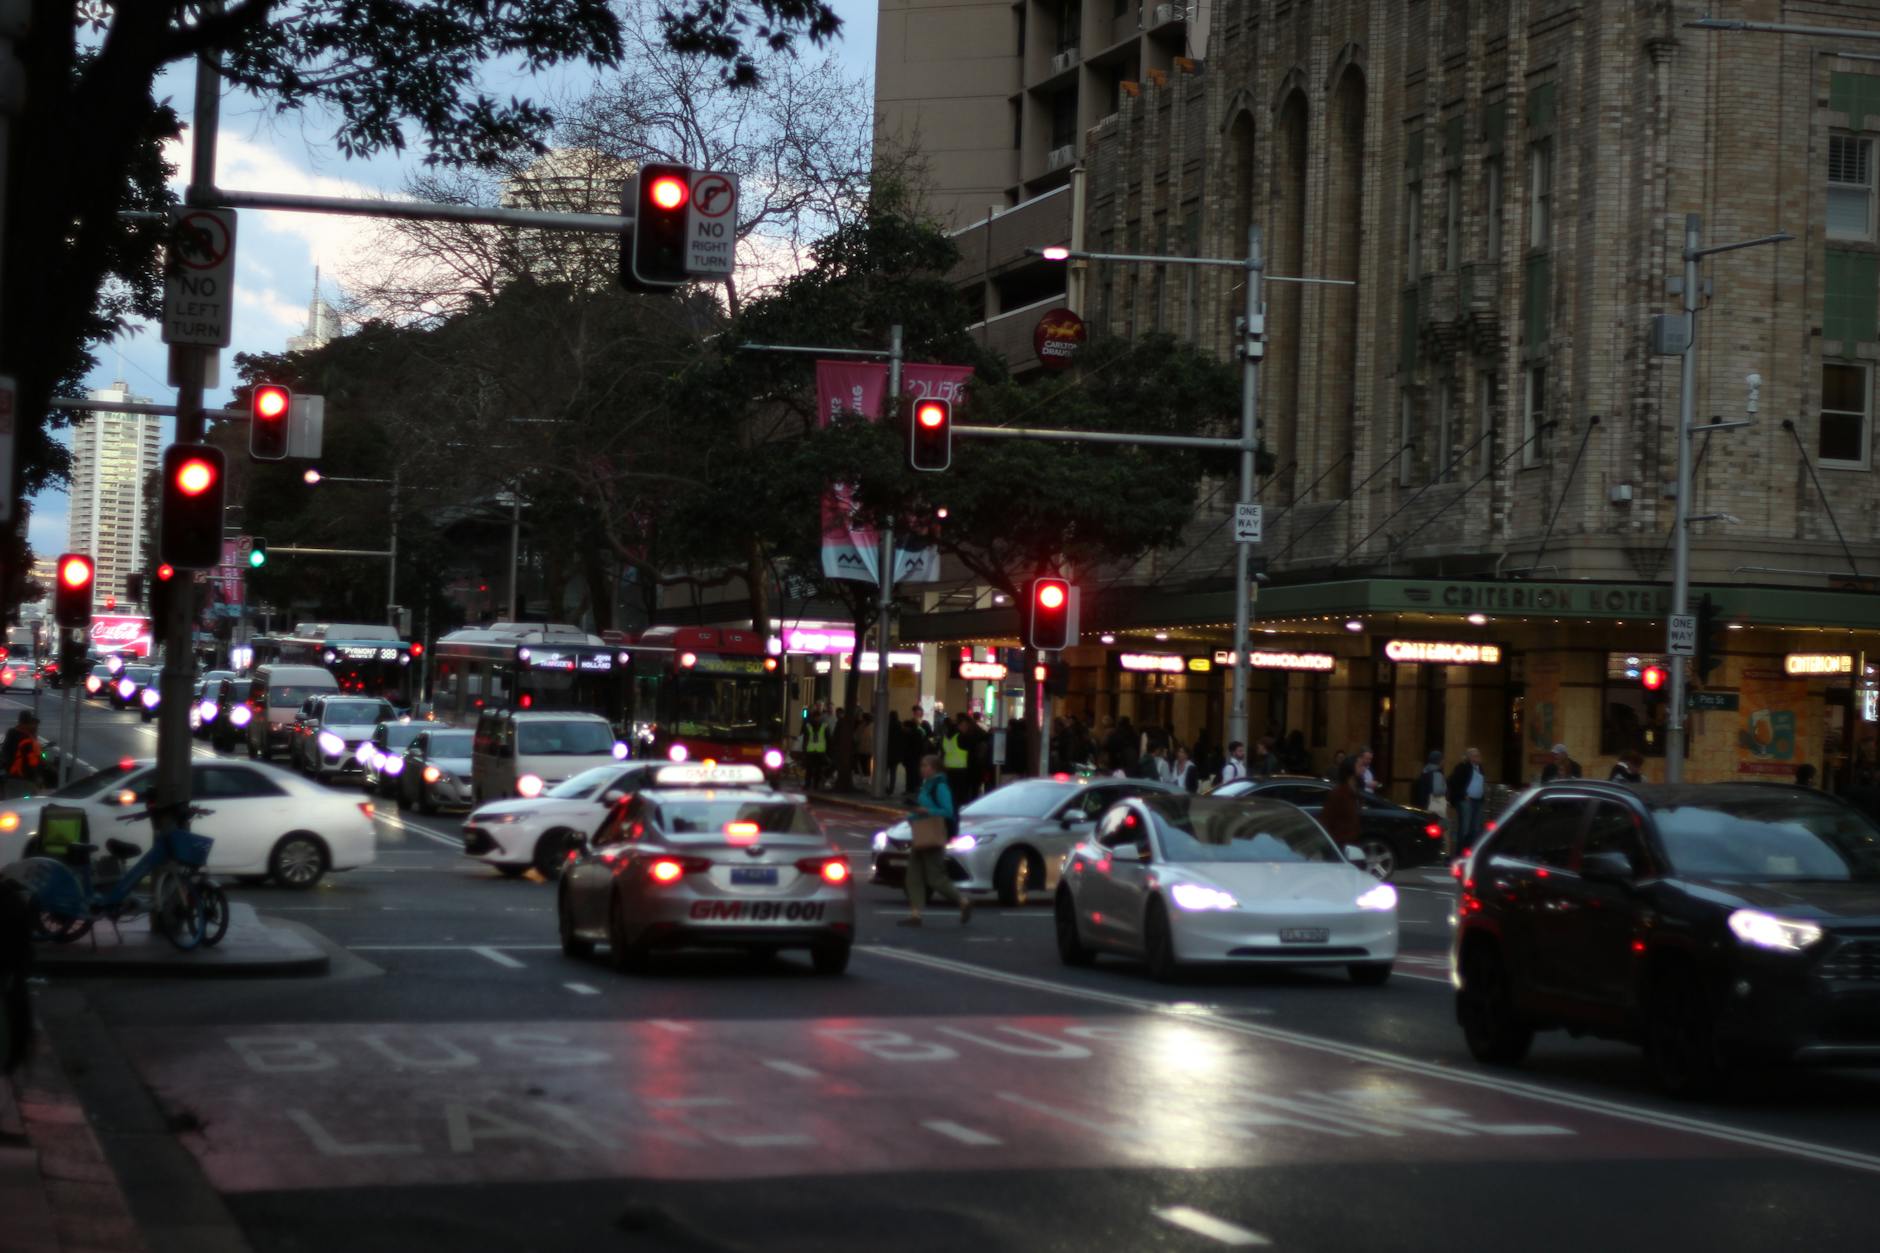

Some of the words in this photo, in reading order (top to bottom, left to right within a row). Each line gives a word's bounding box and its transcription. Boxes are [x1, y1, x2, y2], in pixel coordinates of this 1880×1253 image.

[698, 221, 725, 237] NO
[692, 240, 728, 252] RIGHT
[694, 255, 727, 267] TURN
[179, 276, 216, 297] NO
[176, 302, 220, 317] LEFT
[172, 321, 220, 337] TURN
[1240, 506, 1259, 516] ONE
[1239, 519, 1259, 528] WAY
[1443, 585, 1572, 609] CRITERION
[1673, 618, 1694, 628] ONE
[1672, 631, 1694, 640] WAY
[1386, 641, 1479, 662] CRITERION
[689, 900, 742, 920] GM
[751, 901, 782, 920] 131
[786, 902, 825, 920] 001
[226, 1034, 612, 1073] BUS
